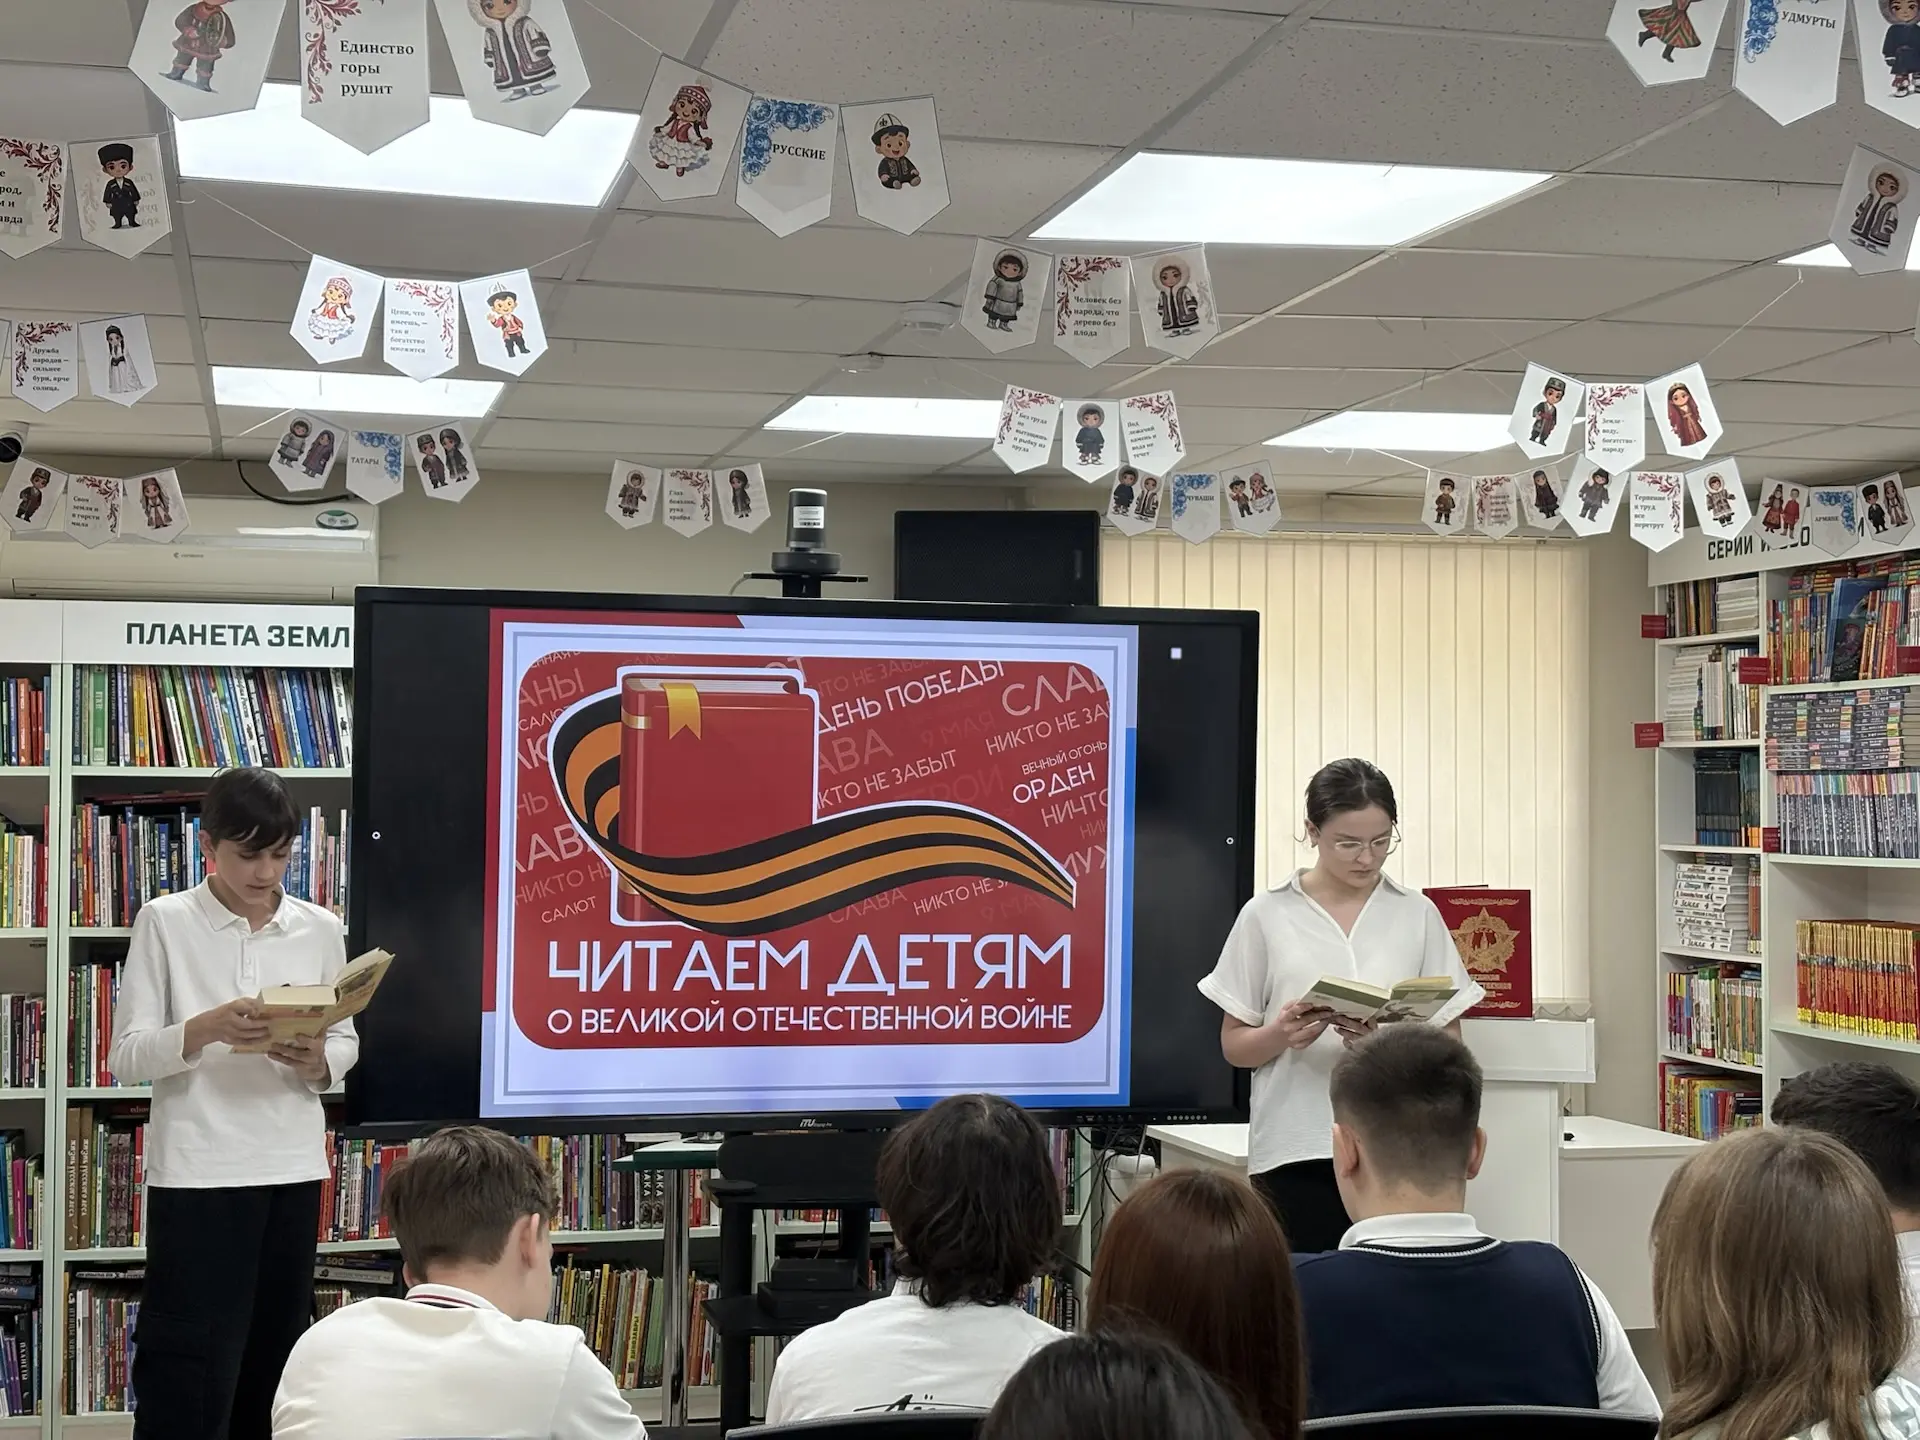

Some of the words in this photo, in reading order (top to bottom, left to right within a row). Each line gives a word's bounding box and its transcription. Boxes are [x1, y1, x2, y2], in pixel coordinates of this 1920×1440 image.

[1781, 10, 1836, 29] УДМУРТЫ
[340, 40, 414, 55] Единство
[340, 63, 380, 77] горы
[341, 84, 393, 97] рушит
[773, 143, 826, 160] РУССКИЕ
[0, 187, 22, 197] род,
[0, 216, 23, 224] авда
[1074, 296, 1107, 304] Человек
[1103, 319, 1116, 327] без
[351, 456, 380, 465] ТАТАРЫ
[1708, 535, 1753, 561] СЕРИИ
[126, 622, 260, 646] ПЛАНЕТА
[267, 625, 350, 648] ЗЕМЛ
[818, 696, 882, 735] ДЕНЬ
[885, 661, 1005, 712] ПОБЕДЫ
[519, 704, 569, 732] САЛЮ
[985, 720, 1051, 756] НИКТО
[1055, 710, 1080, 734] НЕ
[1081, 701, 1109, 725] ЗА
[1022, 750, 1067, 775] ВЕЧНЫЙ
[1068, 740, 1108, 760] ОГОНЬ
[818, 782, 861, 809] КТО
[864, 771, 890, 795] НЕ
[891, 749, 956, 784] ЗАБЫТ
[1012, 762, 1095, 804] ОРДЕН
[541, 896, 597, 924] САЛЮТ
[913, 886, 970, 916] НИКТО
[972, 878, 994, 897] НЕ
[548, 940, 809, 992] ЧИТАЕМ
[827, 934, 1072, 996] ДЕТЯМ
[547, 1008, 573, 1034] О
[580, 1000, 725, 1034] ВЕЛИКОЙ
[731, 997, 973, 1032] ОТЕЧЕСТВЕННОЙ
[980, 997, 1072, 1030] ВОЙНЕ
